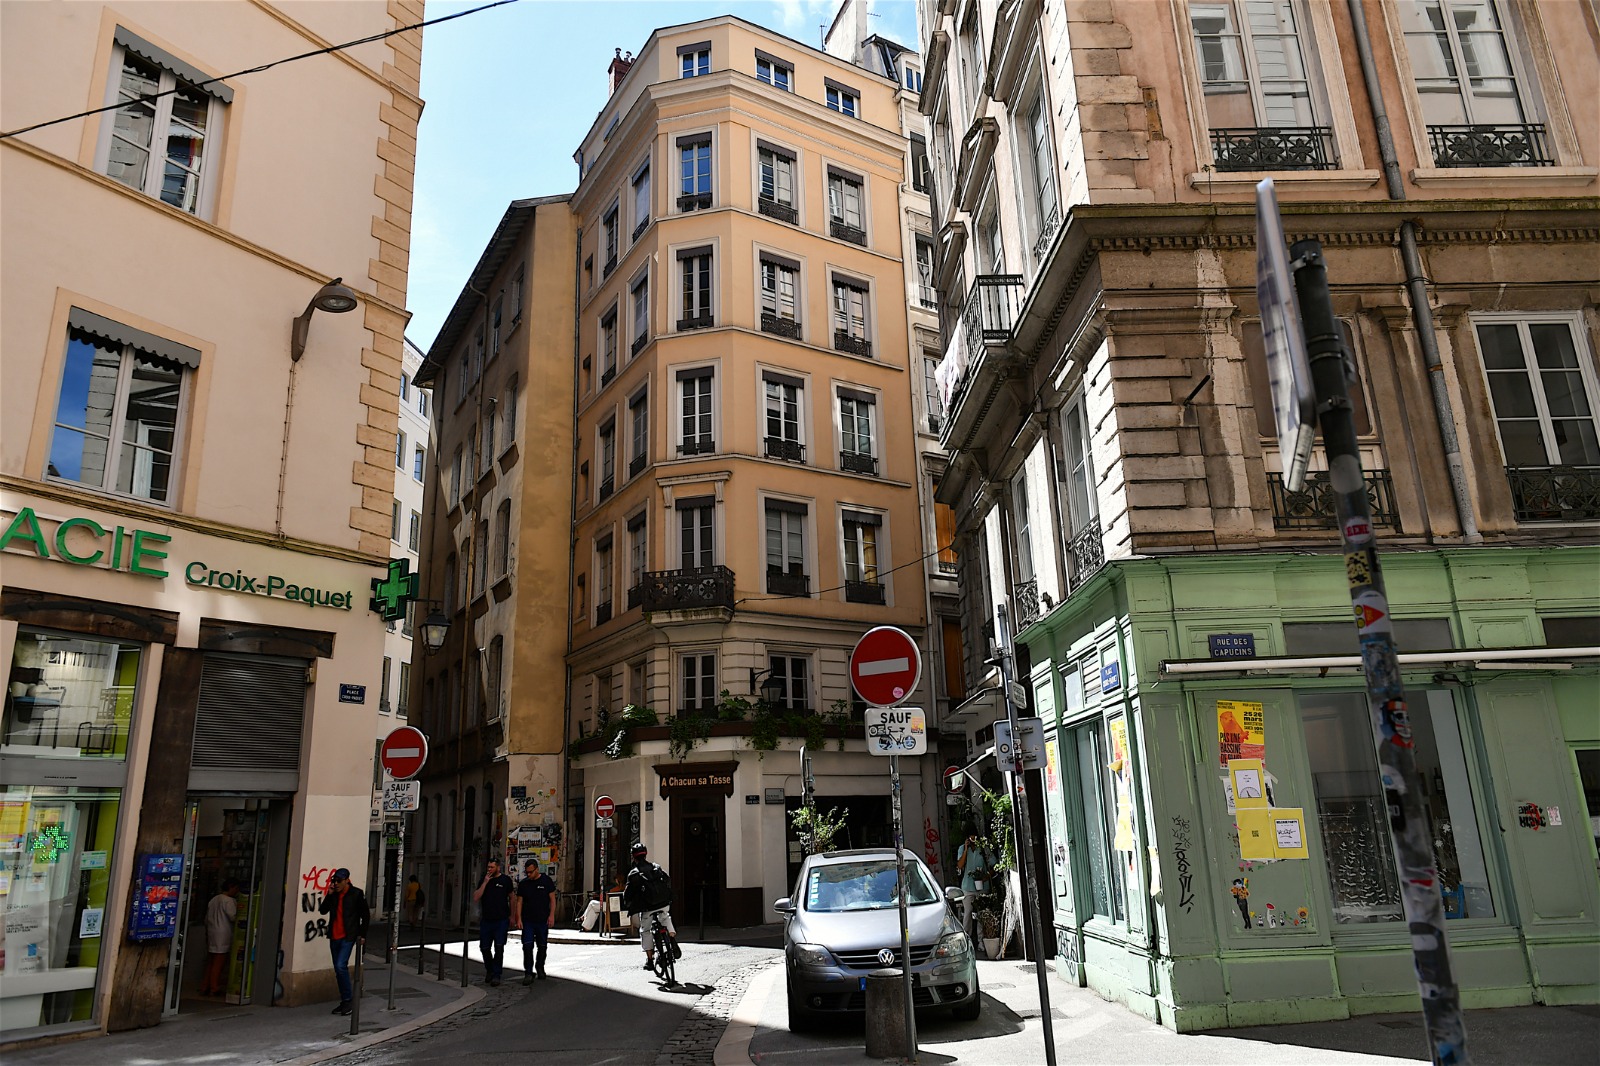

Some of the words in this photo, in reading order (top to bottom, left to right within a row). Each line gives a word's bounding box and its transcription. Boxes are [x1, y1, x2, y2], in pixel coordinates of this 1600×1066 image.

[0, 507, 172, 579] ACIE
[185, 561, 353, 610] Croix-Paquet
[1214, 648, 1253, 656] CAPUCINS
[880, 712, 912, 724] SAUF
[391, 783, 411, 791] SAUF
[661, 777, 667, 787] A
[668, 776, 697, 787] Chacun
[698, 776, 707, 785] sa
[708, 775, 731, 785] Tasse
